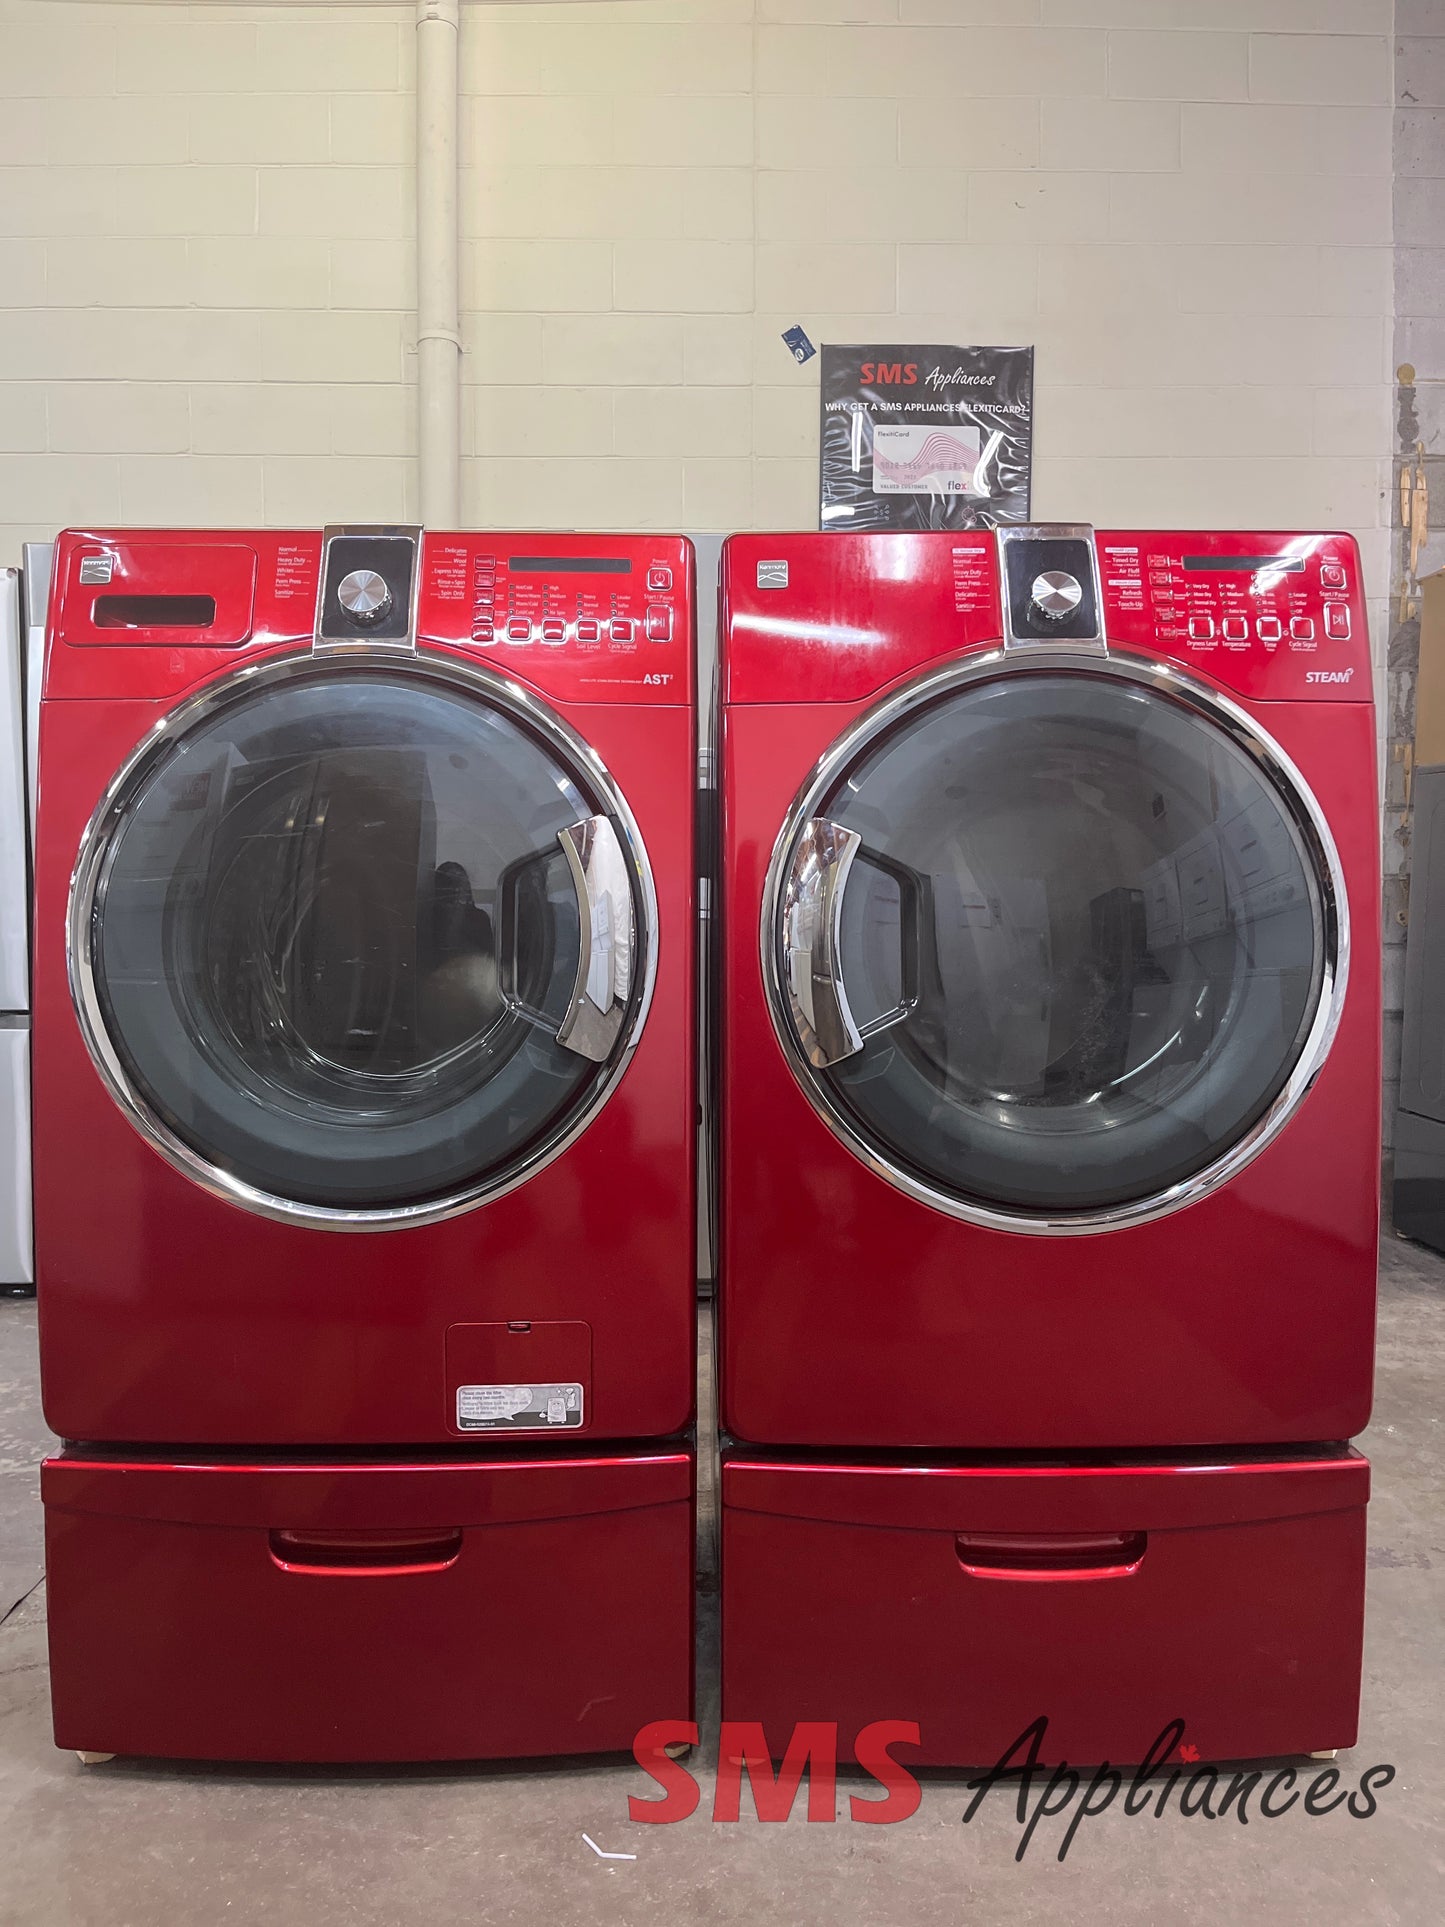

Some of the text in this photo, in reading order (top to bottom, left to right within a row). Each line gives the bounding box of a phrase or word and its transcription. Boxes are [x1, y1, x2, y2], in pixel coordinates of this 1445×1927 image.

[860, 363, 996, 391] SMS Appliances
[825, 402, 848, 412] WHY
[850, 402, 869, 412] GET
[871, 402, 878, 412] A
[880, 403, 902, 412] SMS
[904, 402, 960, 412] APPLIANCES
[293, 556, 306, 564] Duty
[1129, 557, 1139, 565] Dry
[1117, 600, 1144, 608] Touch-Up
[622, 643, 637, 651] Signal
[1186, 640, 1206, 648] Dryness
[1222, 641, 1252, 649] Temperature
[1288, 641, 1318, 649] Cycle Signal
[1306, 671, 1351, 683] STEAM
